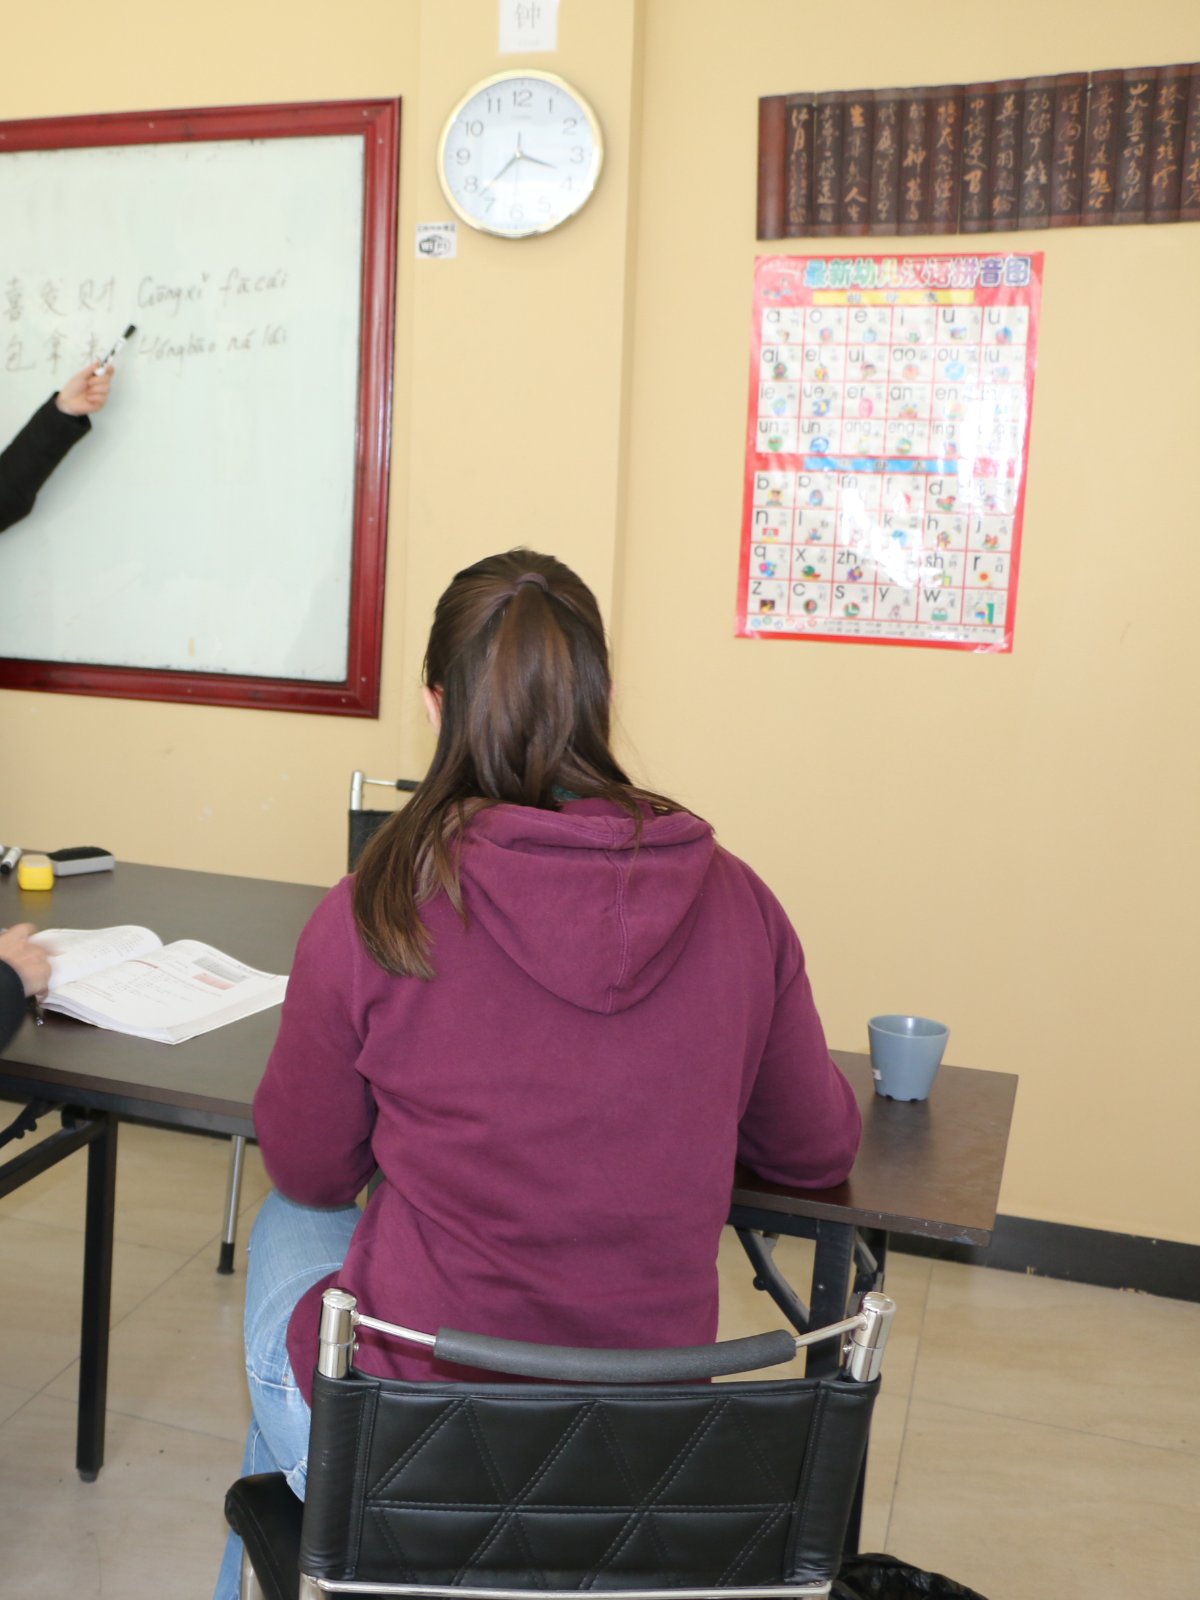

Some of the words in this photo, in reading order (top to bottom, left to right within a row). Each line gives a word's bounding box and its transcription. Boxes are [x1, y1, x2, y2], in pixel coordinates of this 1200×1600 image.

[488, 97, 501, 113] 11
[513, 89, 533, 108] 12
[466, 120, 484, 137] 10
[562, 118, 577, 135] 2
[456, 148, 470, 165] 9
[569, 146, 584, 164] 3
[464, 176, 478, 193] 8
[560, 176, 573, 191] 4
[483, 196, 495, 213] 7
[510, 203, 523, 221] 6
[537, 195, 551, 213] 5
[804, 256, 1030, 288] 最新幼儿汉语拼音图
[766, 310, 781, 324] a
[809, 310, 822, 324] o
[854, 310, 868, 323] e
[942, 309, 956, 324] u
[892, 347, 916, 362] ao
[937, 348, 960, 362] ou
[984, 347, 1001, 363] iu
[760, 384, 775, 399] ie
[847, 385, 865, 399] er
[890, 386, 913, 400] an
[935, 387, 958, 400] en
[759, 420, 779, 434] un
[757, 475, 770, 490] b
[798, 475, 811, 489] p
[929, 479, 943, 496] d
[755, 509, 769, 526] n
[927, 515, 938, 531] h
[754, 545, 767, 560] q
[796, 548, 807, 562] x
[837, 550, 858, 565] zh
[925, 552, 945, 569] sh
[752, 581, 762, 596] z
[793, 583, 806, 597] c
[834, 585, 845, 600] s
[879, 587, 889, 602] y
[923, 589, 941, 604] w
